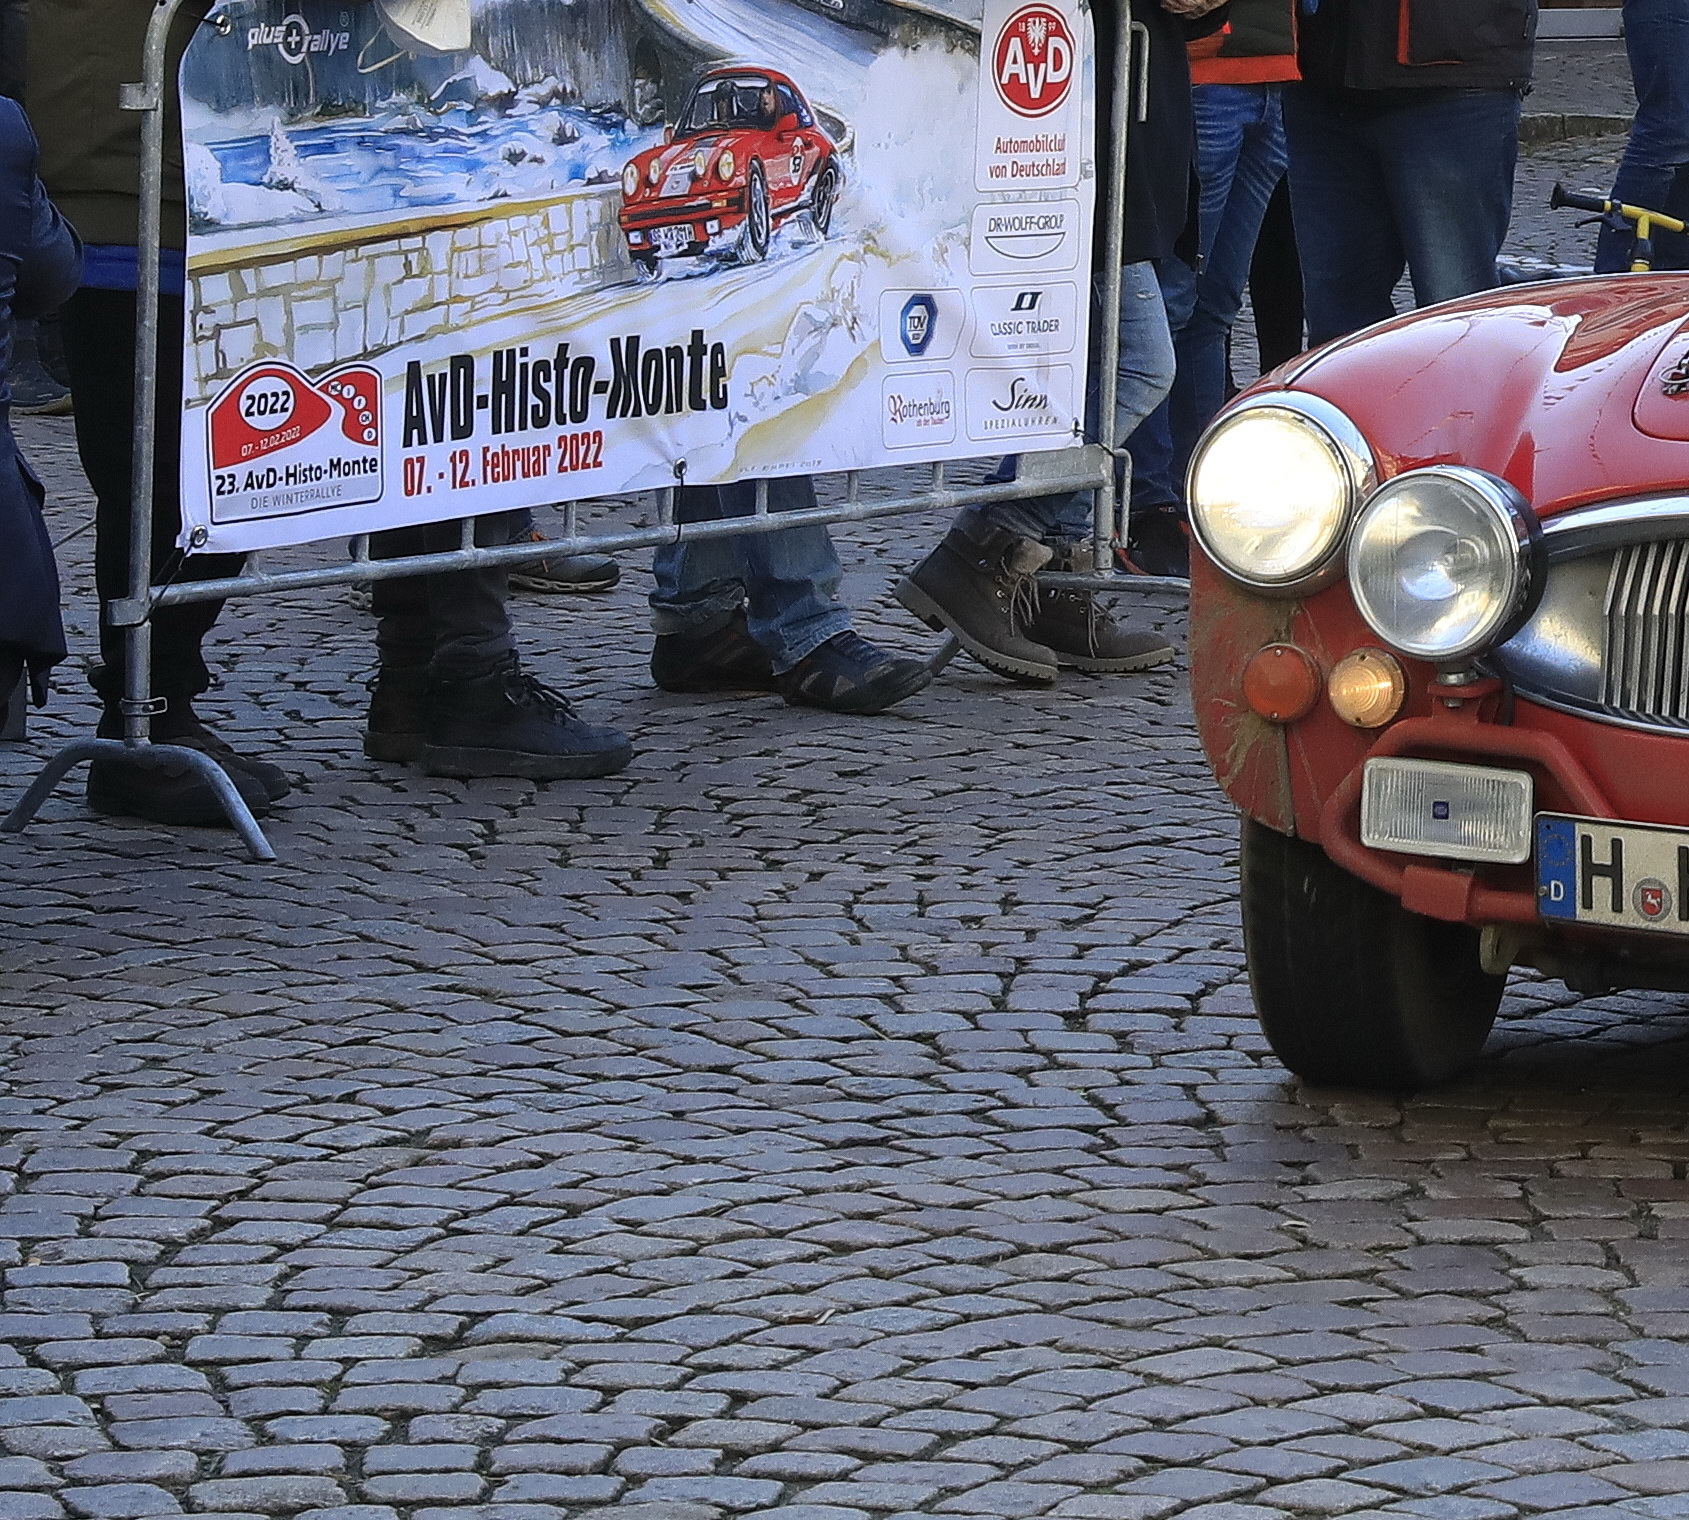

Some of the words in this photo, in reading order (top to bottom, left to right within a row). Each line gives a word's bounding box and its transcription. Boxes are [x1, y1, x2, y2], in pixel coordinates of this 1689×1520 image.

[988, 164, 1007, 180] von
[1025, 318, 1060, 334] TRADER
[244, 390, 291, 418] 2022
[402, 328, 729, 450] AvD-Histo-Monte
[991, 377, 1048, 412] Sinn
[888, 394, 951, 425] Rothenburg
[215, 472, 240, 497] 23.
[243, 456, 379, 493] AvD-Histo-Monte
[403, 456, 433, 498] 07.
[450, 450, 478, 490] 12.
[481, 441, 553, 485] Februar
[556, 430, 605, 471] 2022
[250, 496, 269, 511] DIE
[271, 484, 343, 508] WINTERRALLYE
[1580, 833, 1624, 914] H
[1550, 879, 1565, 902] D
